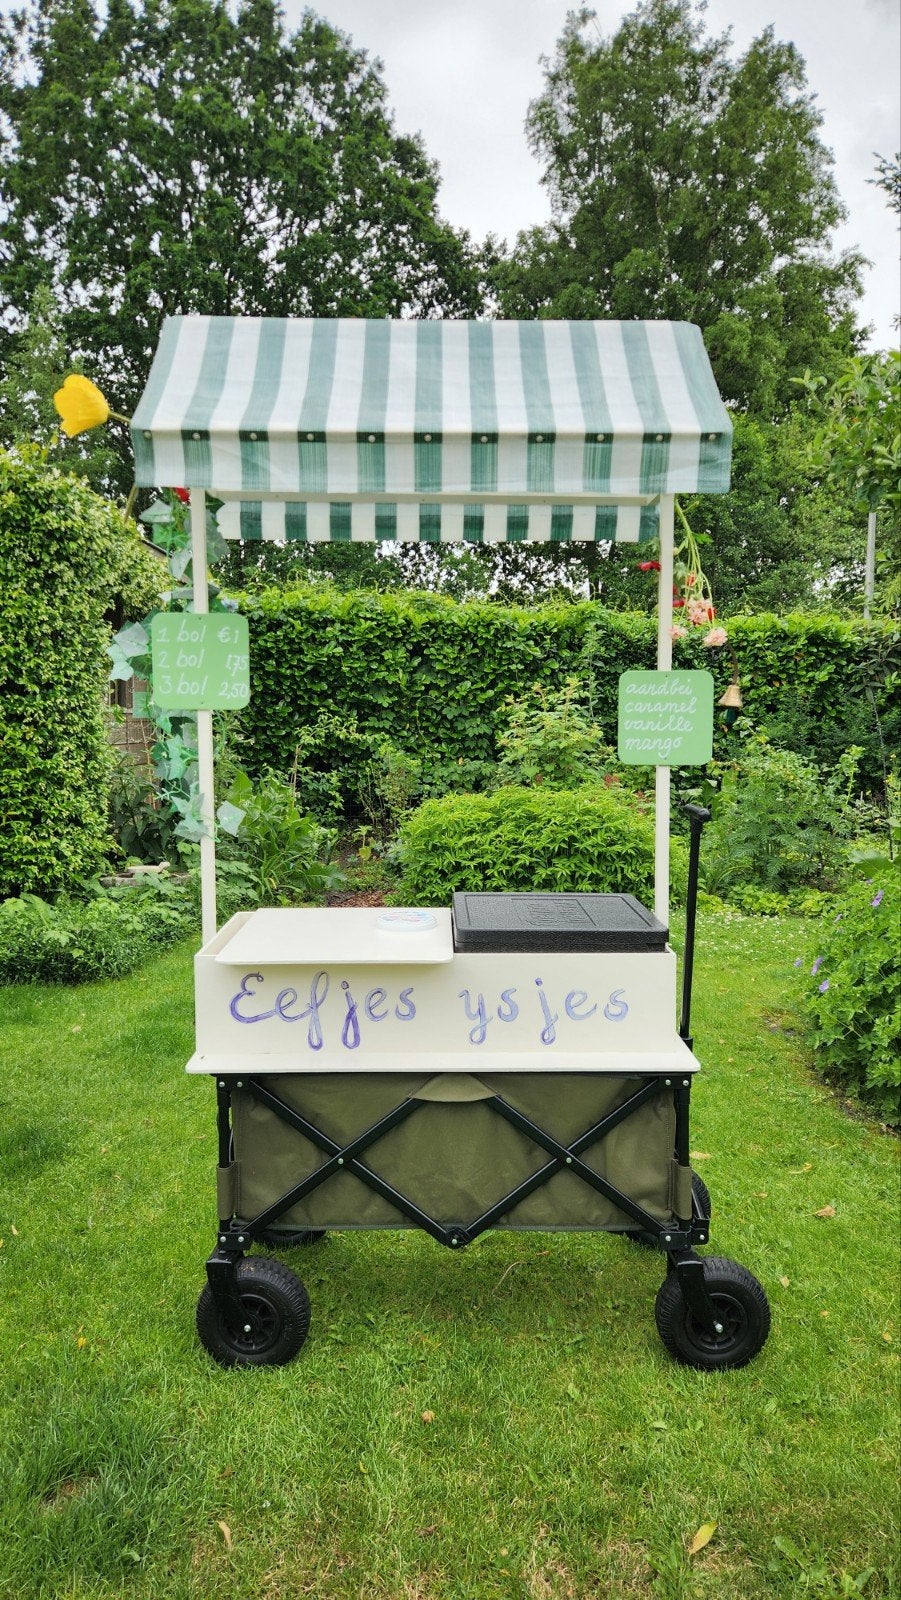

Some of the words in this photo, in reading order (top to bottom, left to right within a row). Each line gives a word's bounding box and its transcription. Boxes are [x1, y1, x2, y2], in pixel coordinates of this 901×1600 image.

[157, 627, 169, 642] 1
[177, 619, 207, 642] bol
[158, 651, 170, 668] 2
[177, 648, 205, 668] bol
[160, 675, 173, 694] 3
[177, 672, 208, 695] bol
[218, 681, 249, 699] 2,50
[625, 678, 692, 695] aardbei
[624, 696, 698, 713] caramel
[624, 713, 693, 731] vanille
[625, 736, 683, 758] mango
[229, 971, 416, 1051] Eefjes
[458, 977, 629, 1045] ysjes
